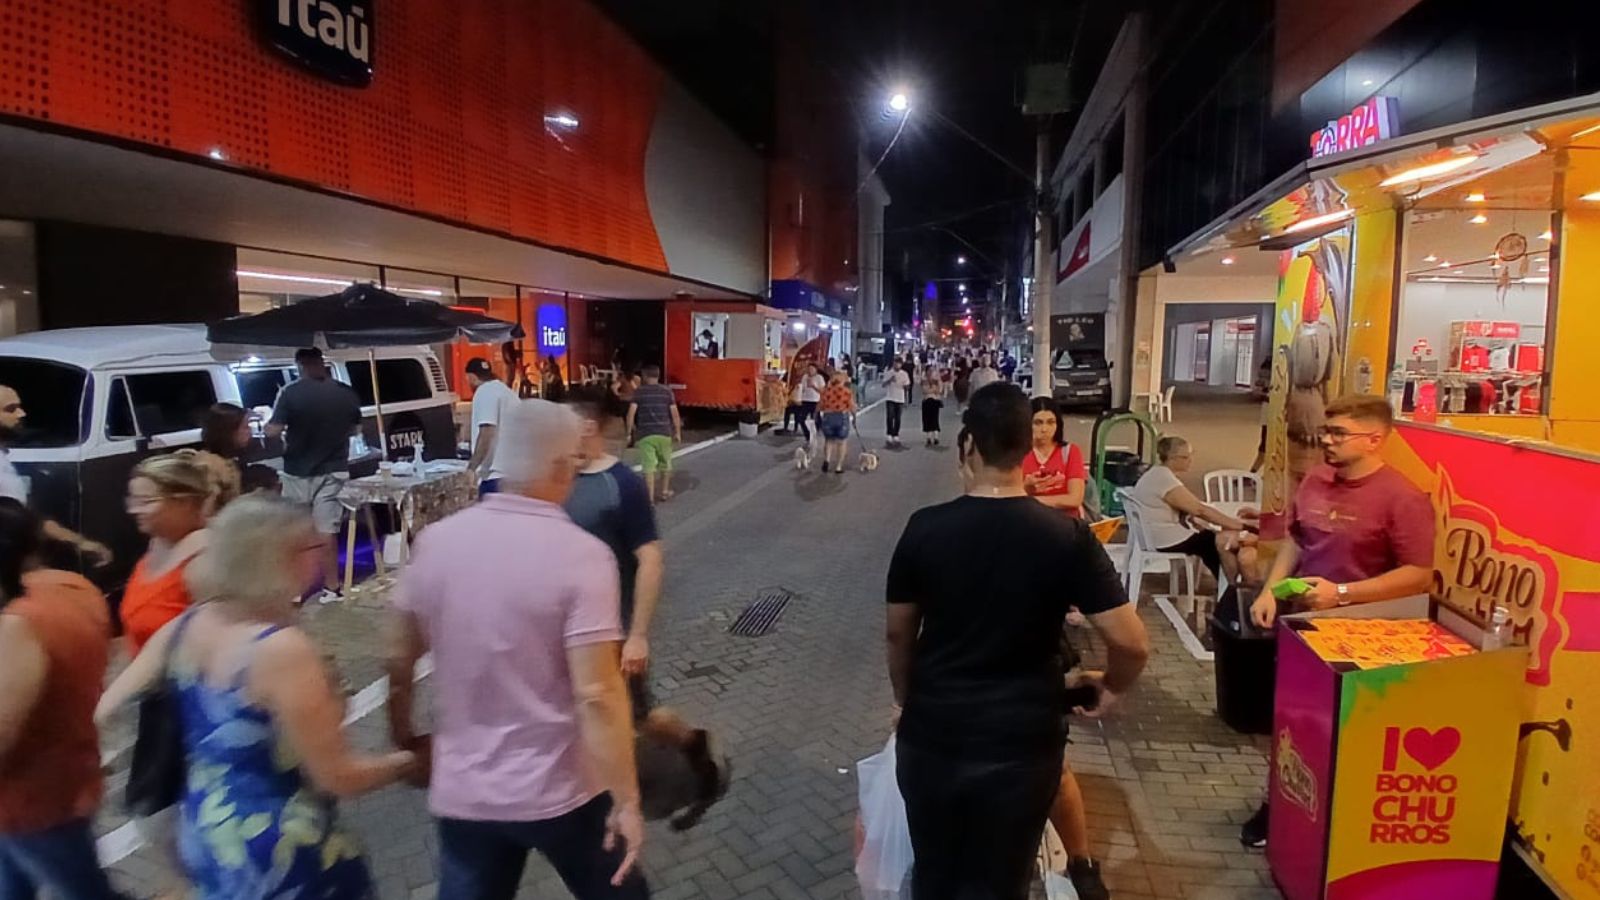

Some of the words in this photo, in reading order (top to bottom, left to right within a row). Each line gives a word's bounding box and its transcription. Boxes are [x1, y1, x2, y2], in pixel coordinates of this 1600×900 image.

[543, 325, 566, 347] itaú
[1446, 528, 1537, 608] Bono
[1382, 727, 1400, 771] I
[1376, 774, 1458, 794] BONO
[1373, 795, 1456, 823] CHU
[1370, 823, 1452, 845] RROS
